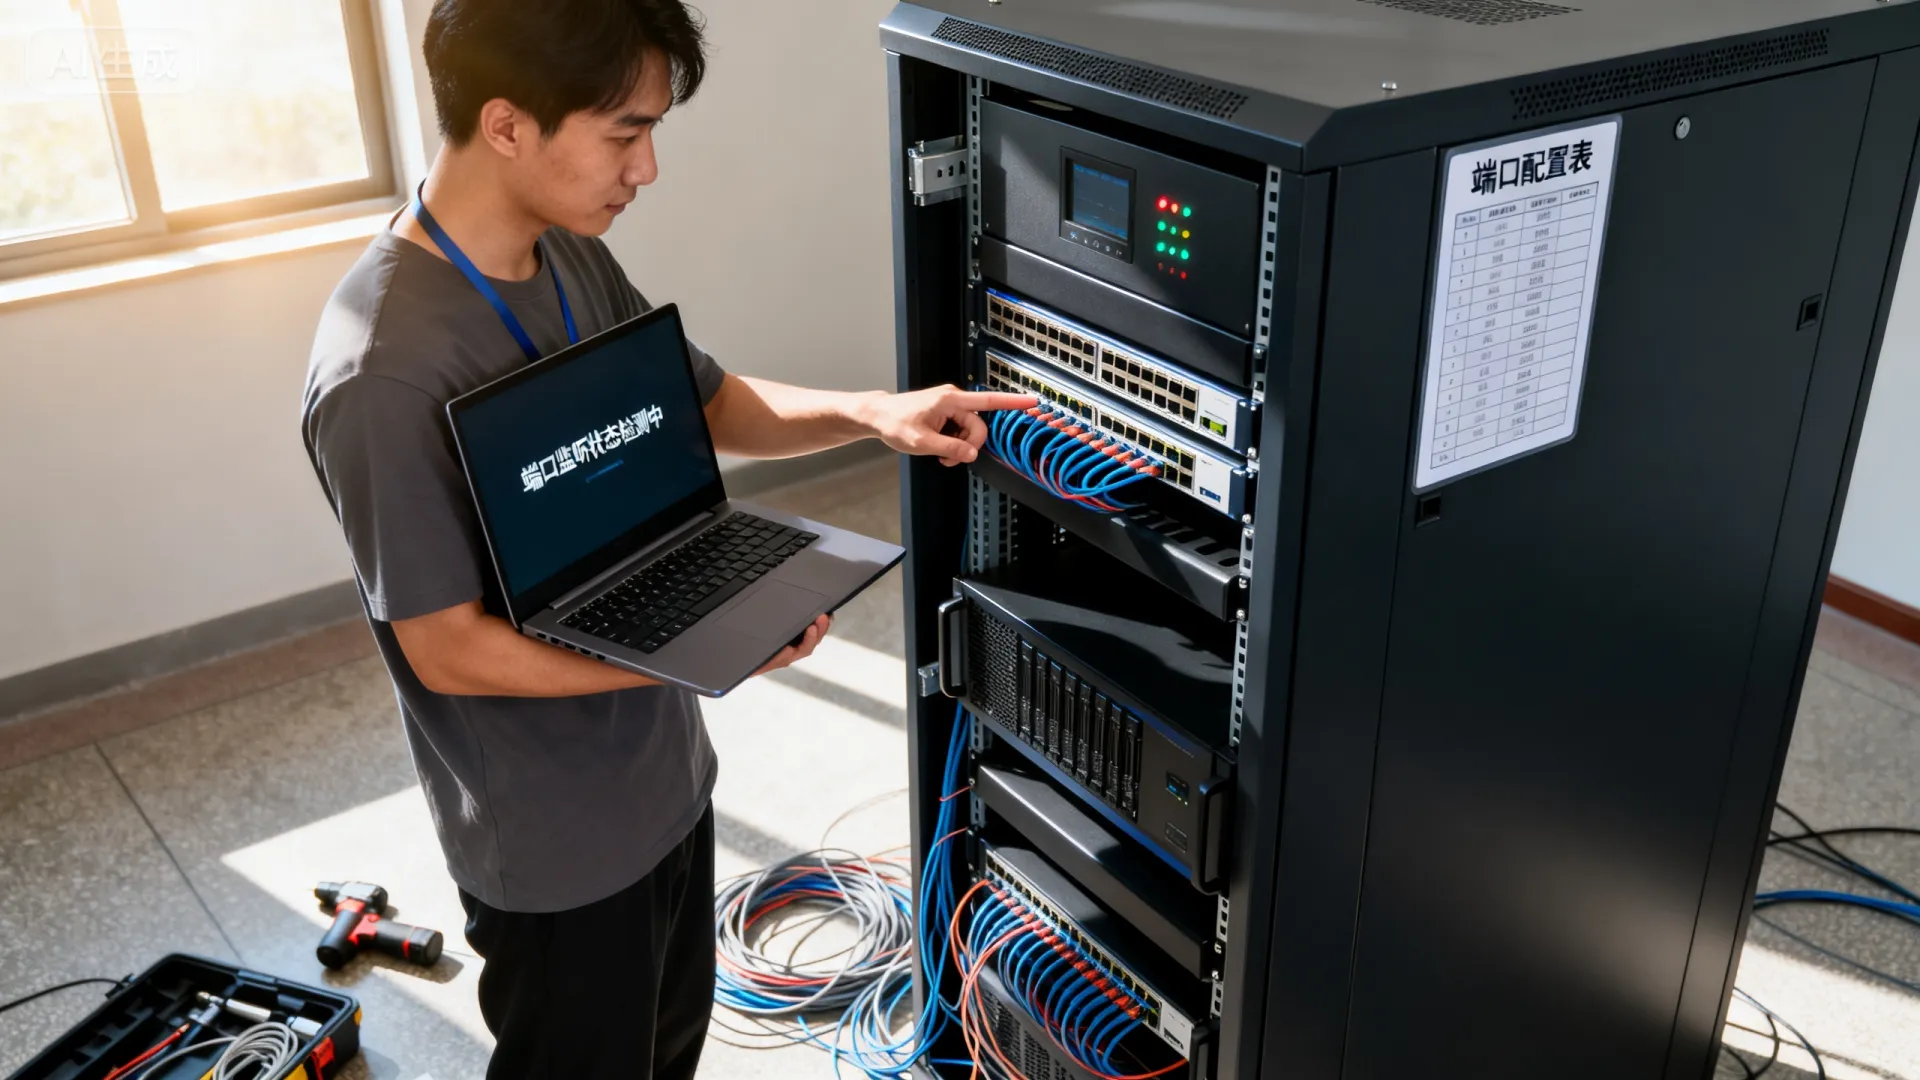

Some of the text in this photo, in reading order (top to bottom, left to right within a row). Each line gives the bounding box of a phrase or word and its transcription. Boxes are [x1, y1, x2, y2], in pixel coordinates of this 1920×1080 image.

[1471, 139, 1593, 196] 端口配置表
